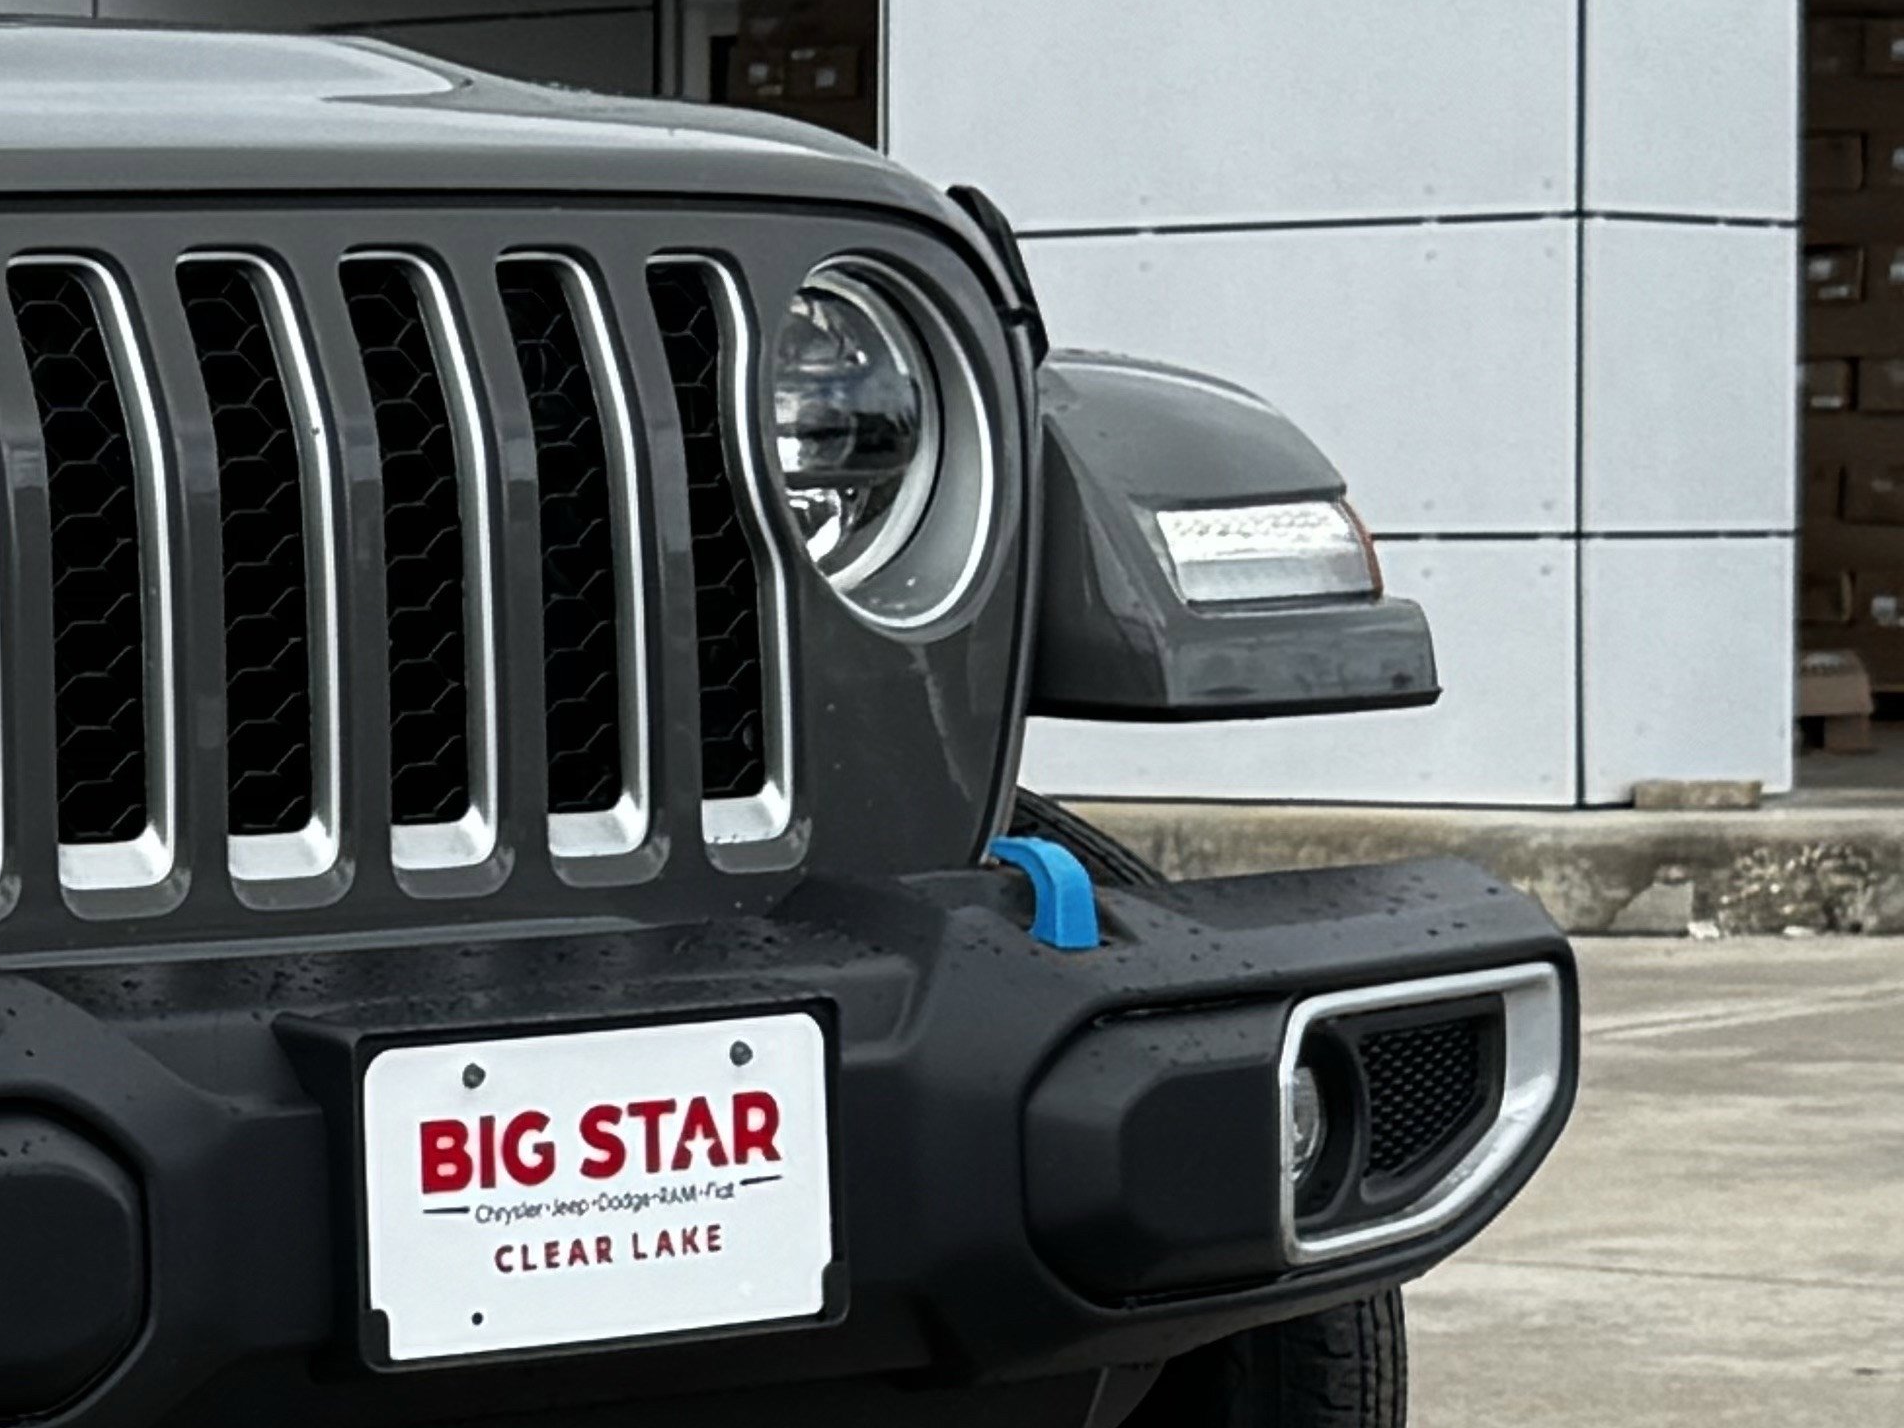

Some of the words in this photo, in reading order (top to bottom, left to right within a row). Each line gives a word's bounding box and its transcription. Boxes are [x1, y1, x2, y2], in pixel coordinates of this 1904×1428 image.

[418, 1110, 556, 1195] BIG
[578, 1090, 782, 1180] STAR
[494, 1234, 613, 1274] CLEAR
[632, 1223, 723, 1262] LAKE
